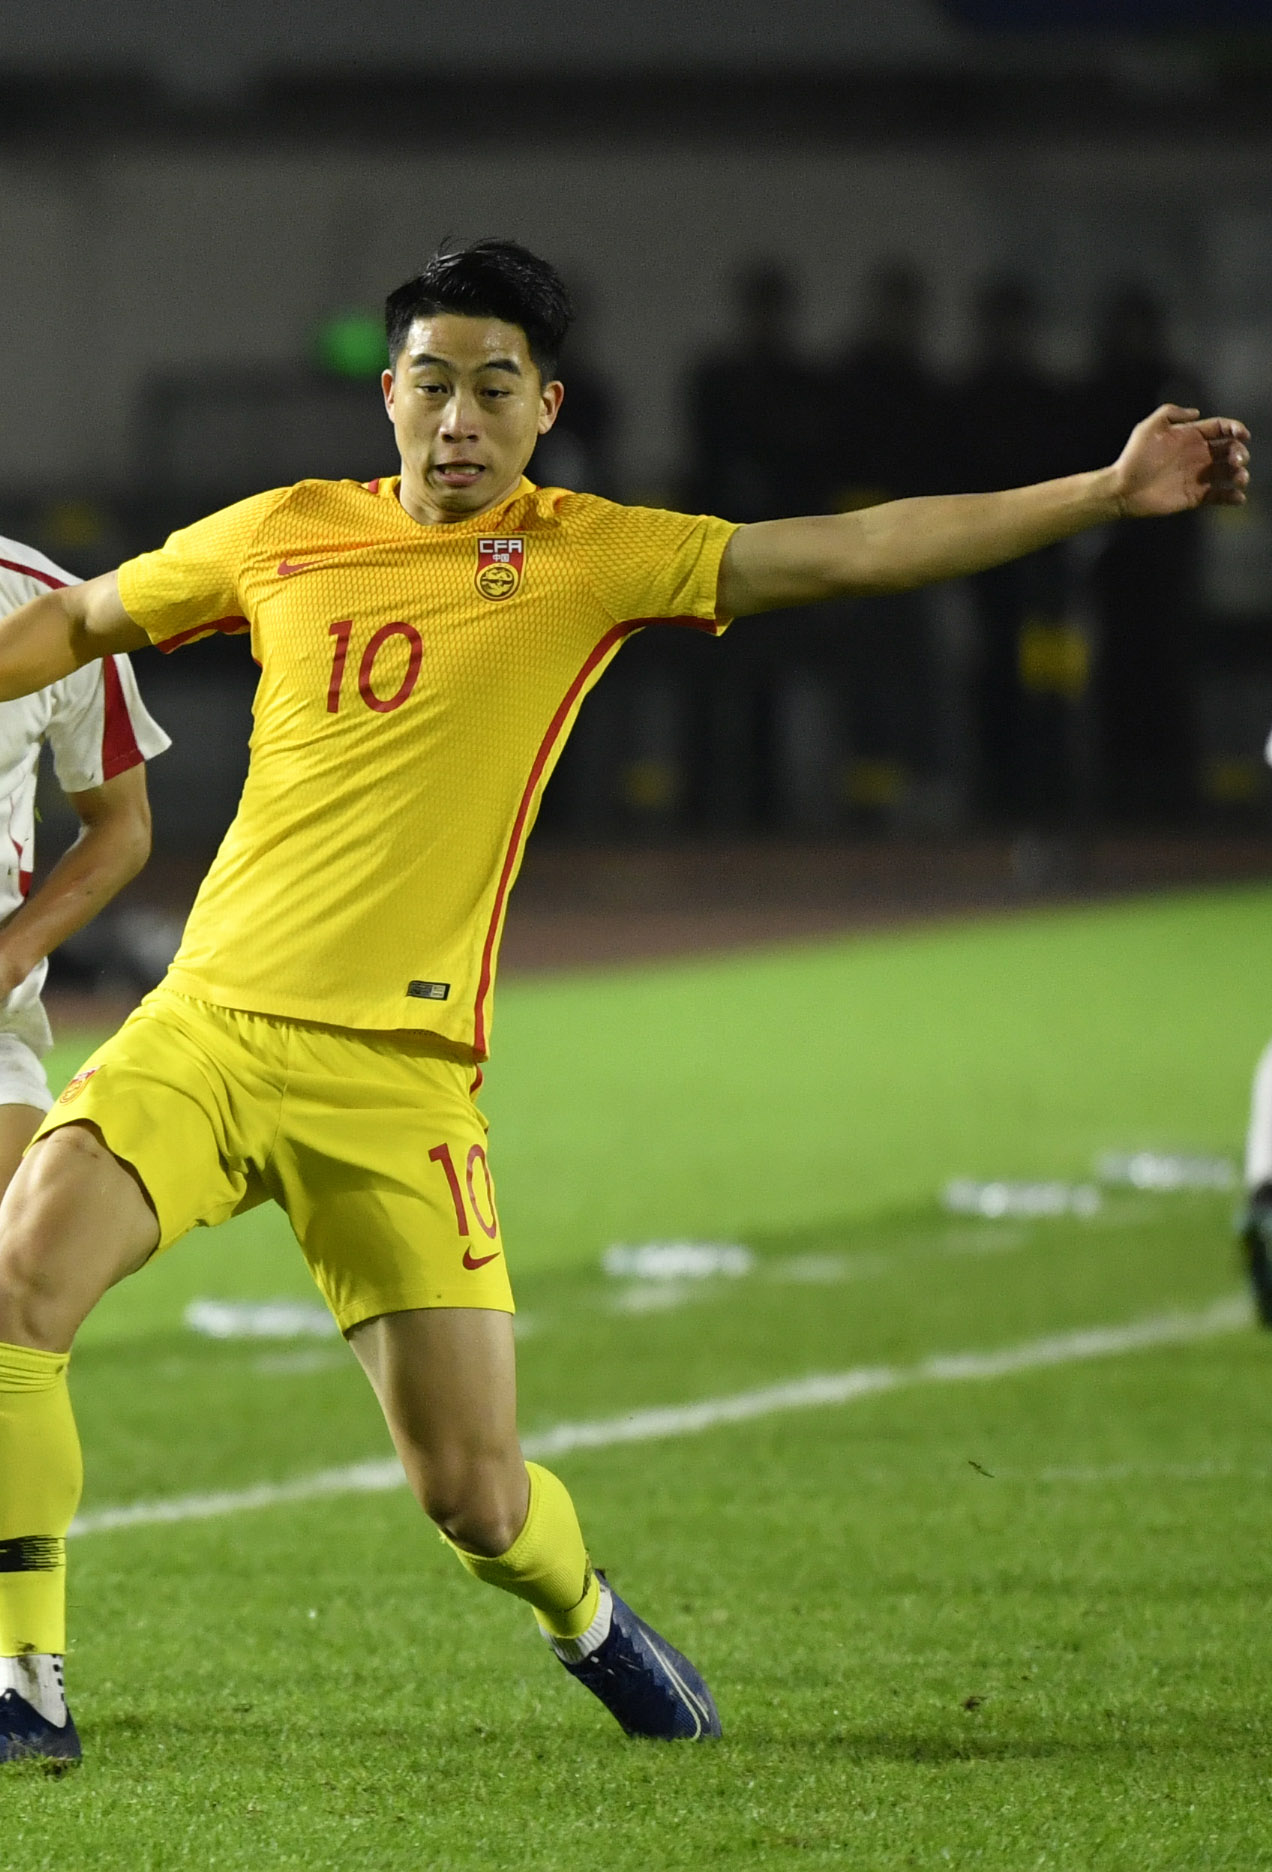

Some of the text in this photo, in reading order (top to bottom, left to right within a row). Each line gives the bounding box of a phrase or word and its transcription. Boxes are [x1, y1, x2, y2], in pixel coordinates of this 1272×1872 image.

[479, 540, 522, 553] CFA
[327, 620, 423, 713] 10
[428, 1142, 497, 1239] 10
